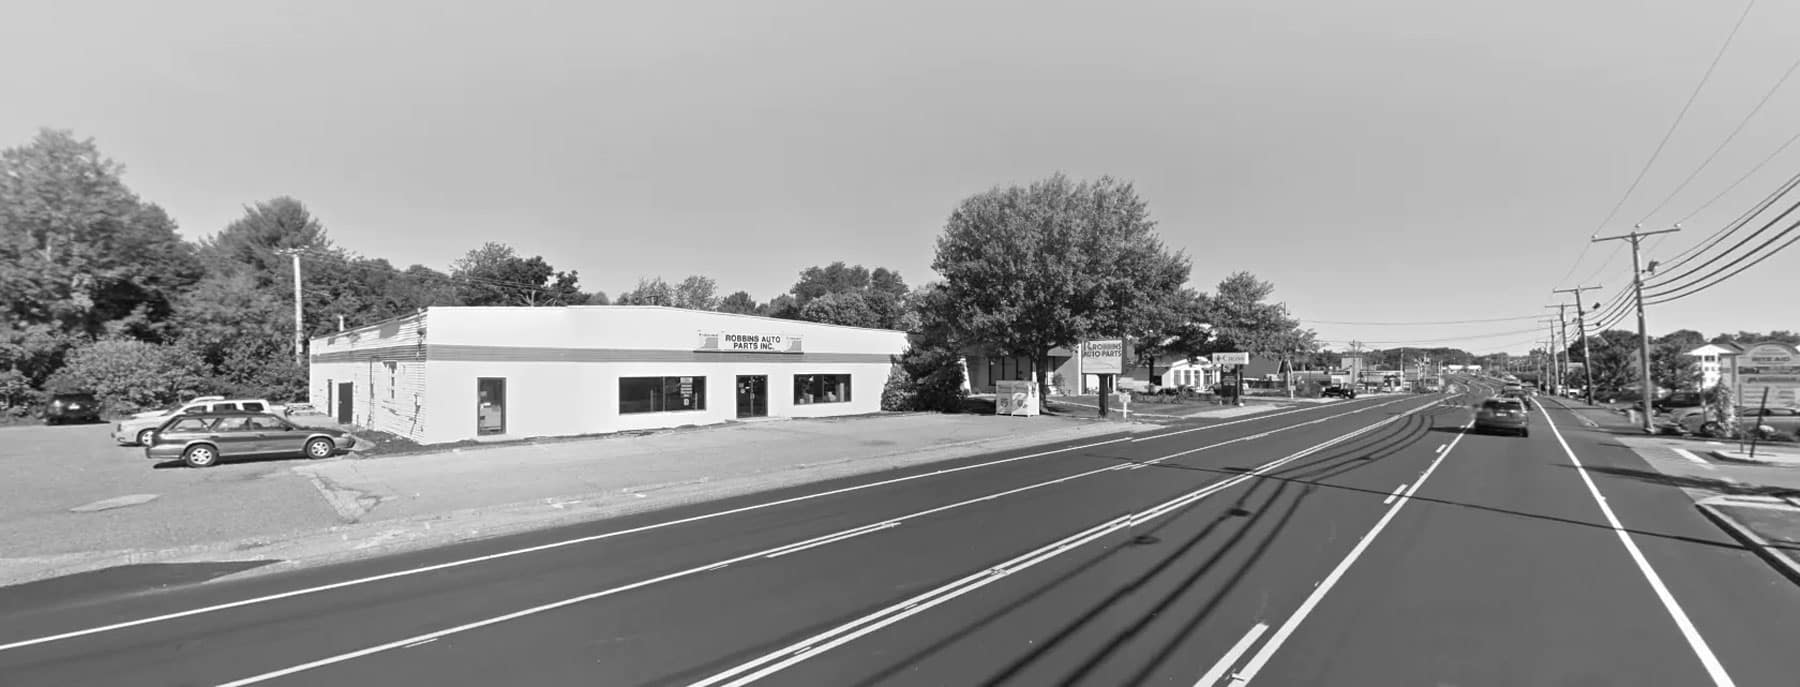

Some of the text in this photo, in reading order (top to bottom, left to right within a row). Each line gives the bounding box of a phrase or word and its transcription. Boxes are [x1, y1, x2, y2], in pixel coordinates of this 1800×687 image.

[725, 334, 760, 343] ROBBINS
[761, 335, 781, 344] AUTO
[733, 342, 759, 350] PARTS
